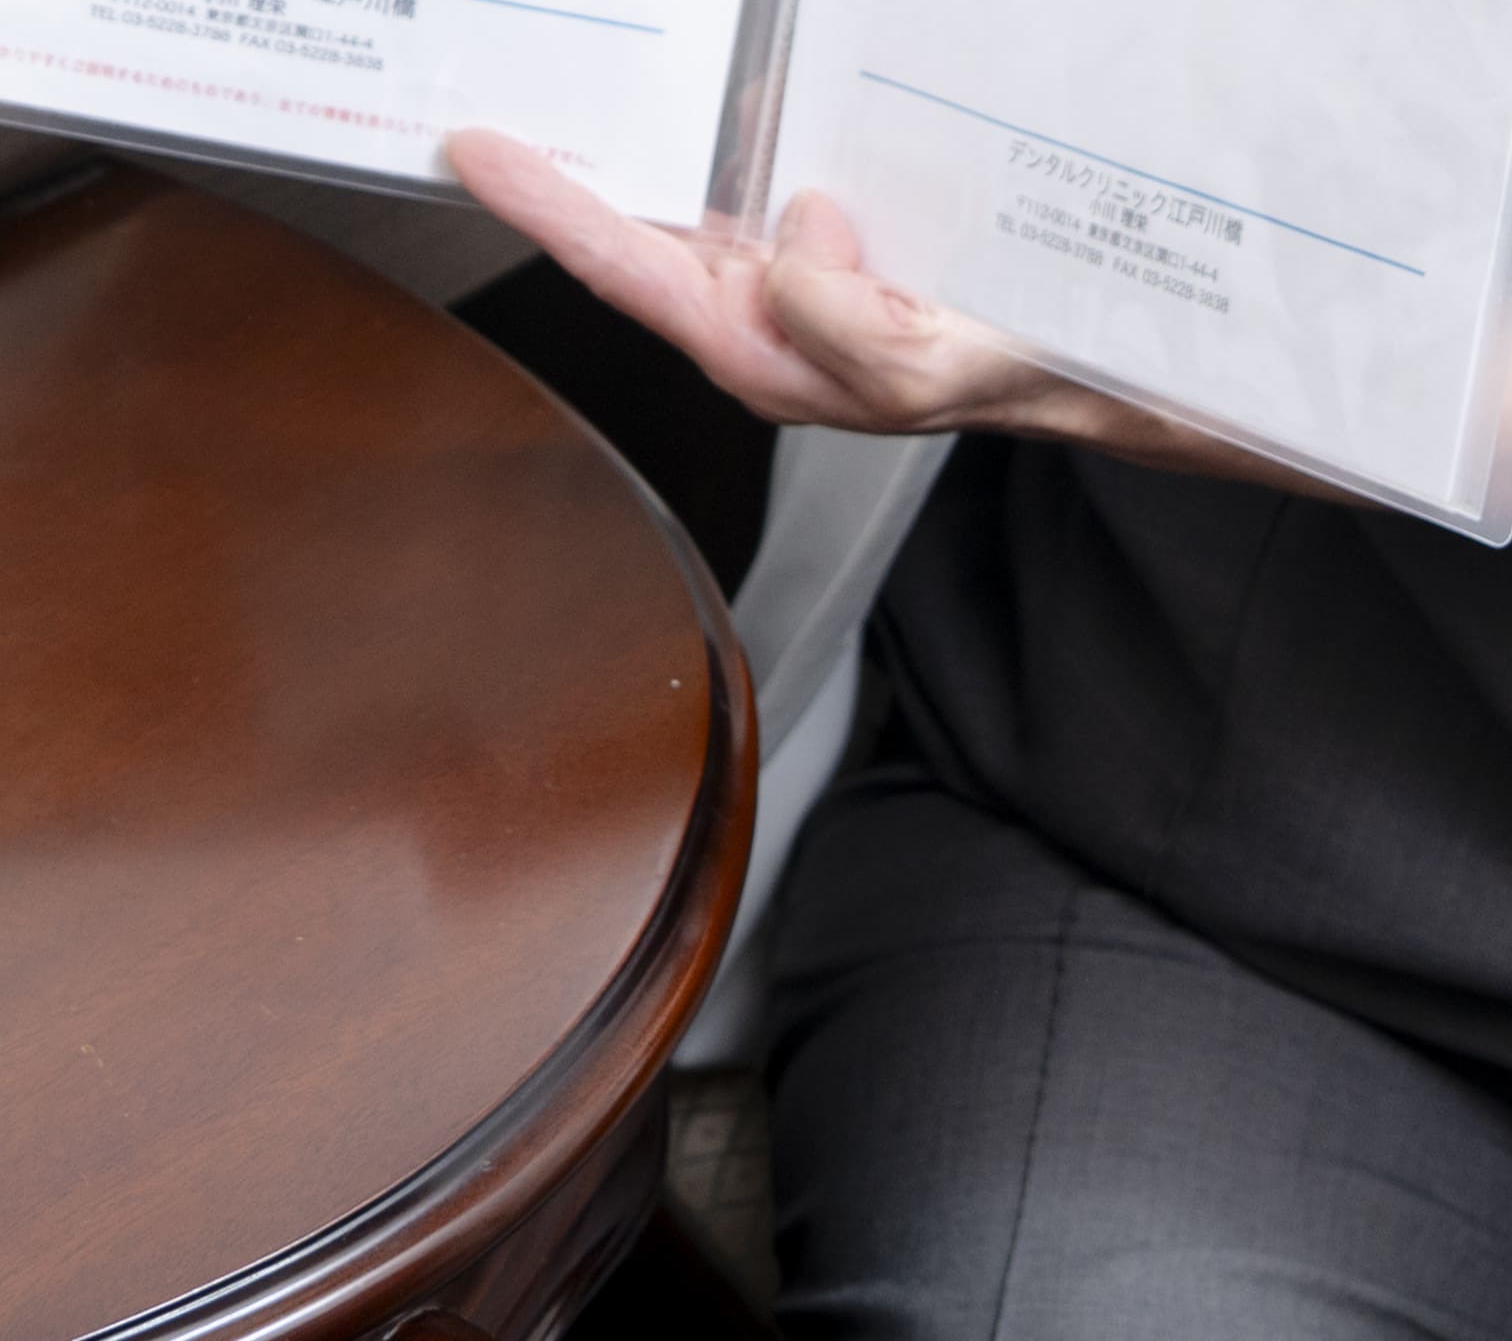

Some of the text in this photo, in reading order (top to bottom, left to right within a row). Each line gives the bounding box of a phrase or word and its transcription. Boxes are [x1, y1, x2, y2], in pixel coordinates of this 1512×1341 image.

[1007, 138, 1245, 247] デンタルクリニック江戸川橋
